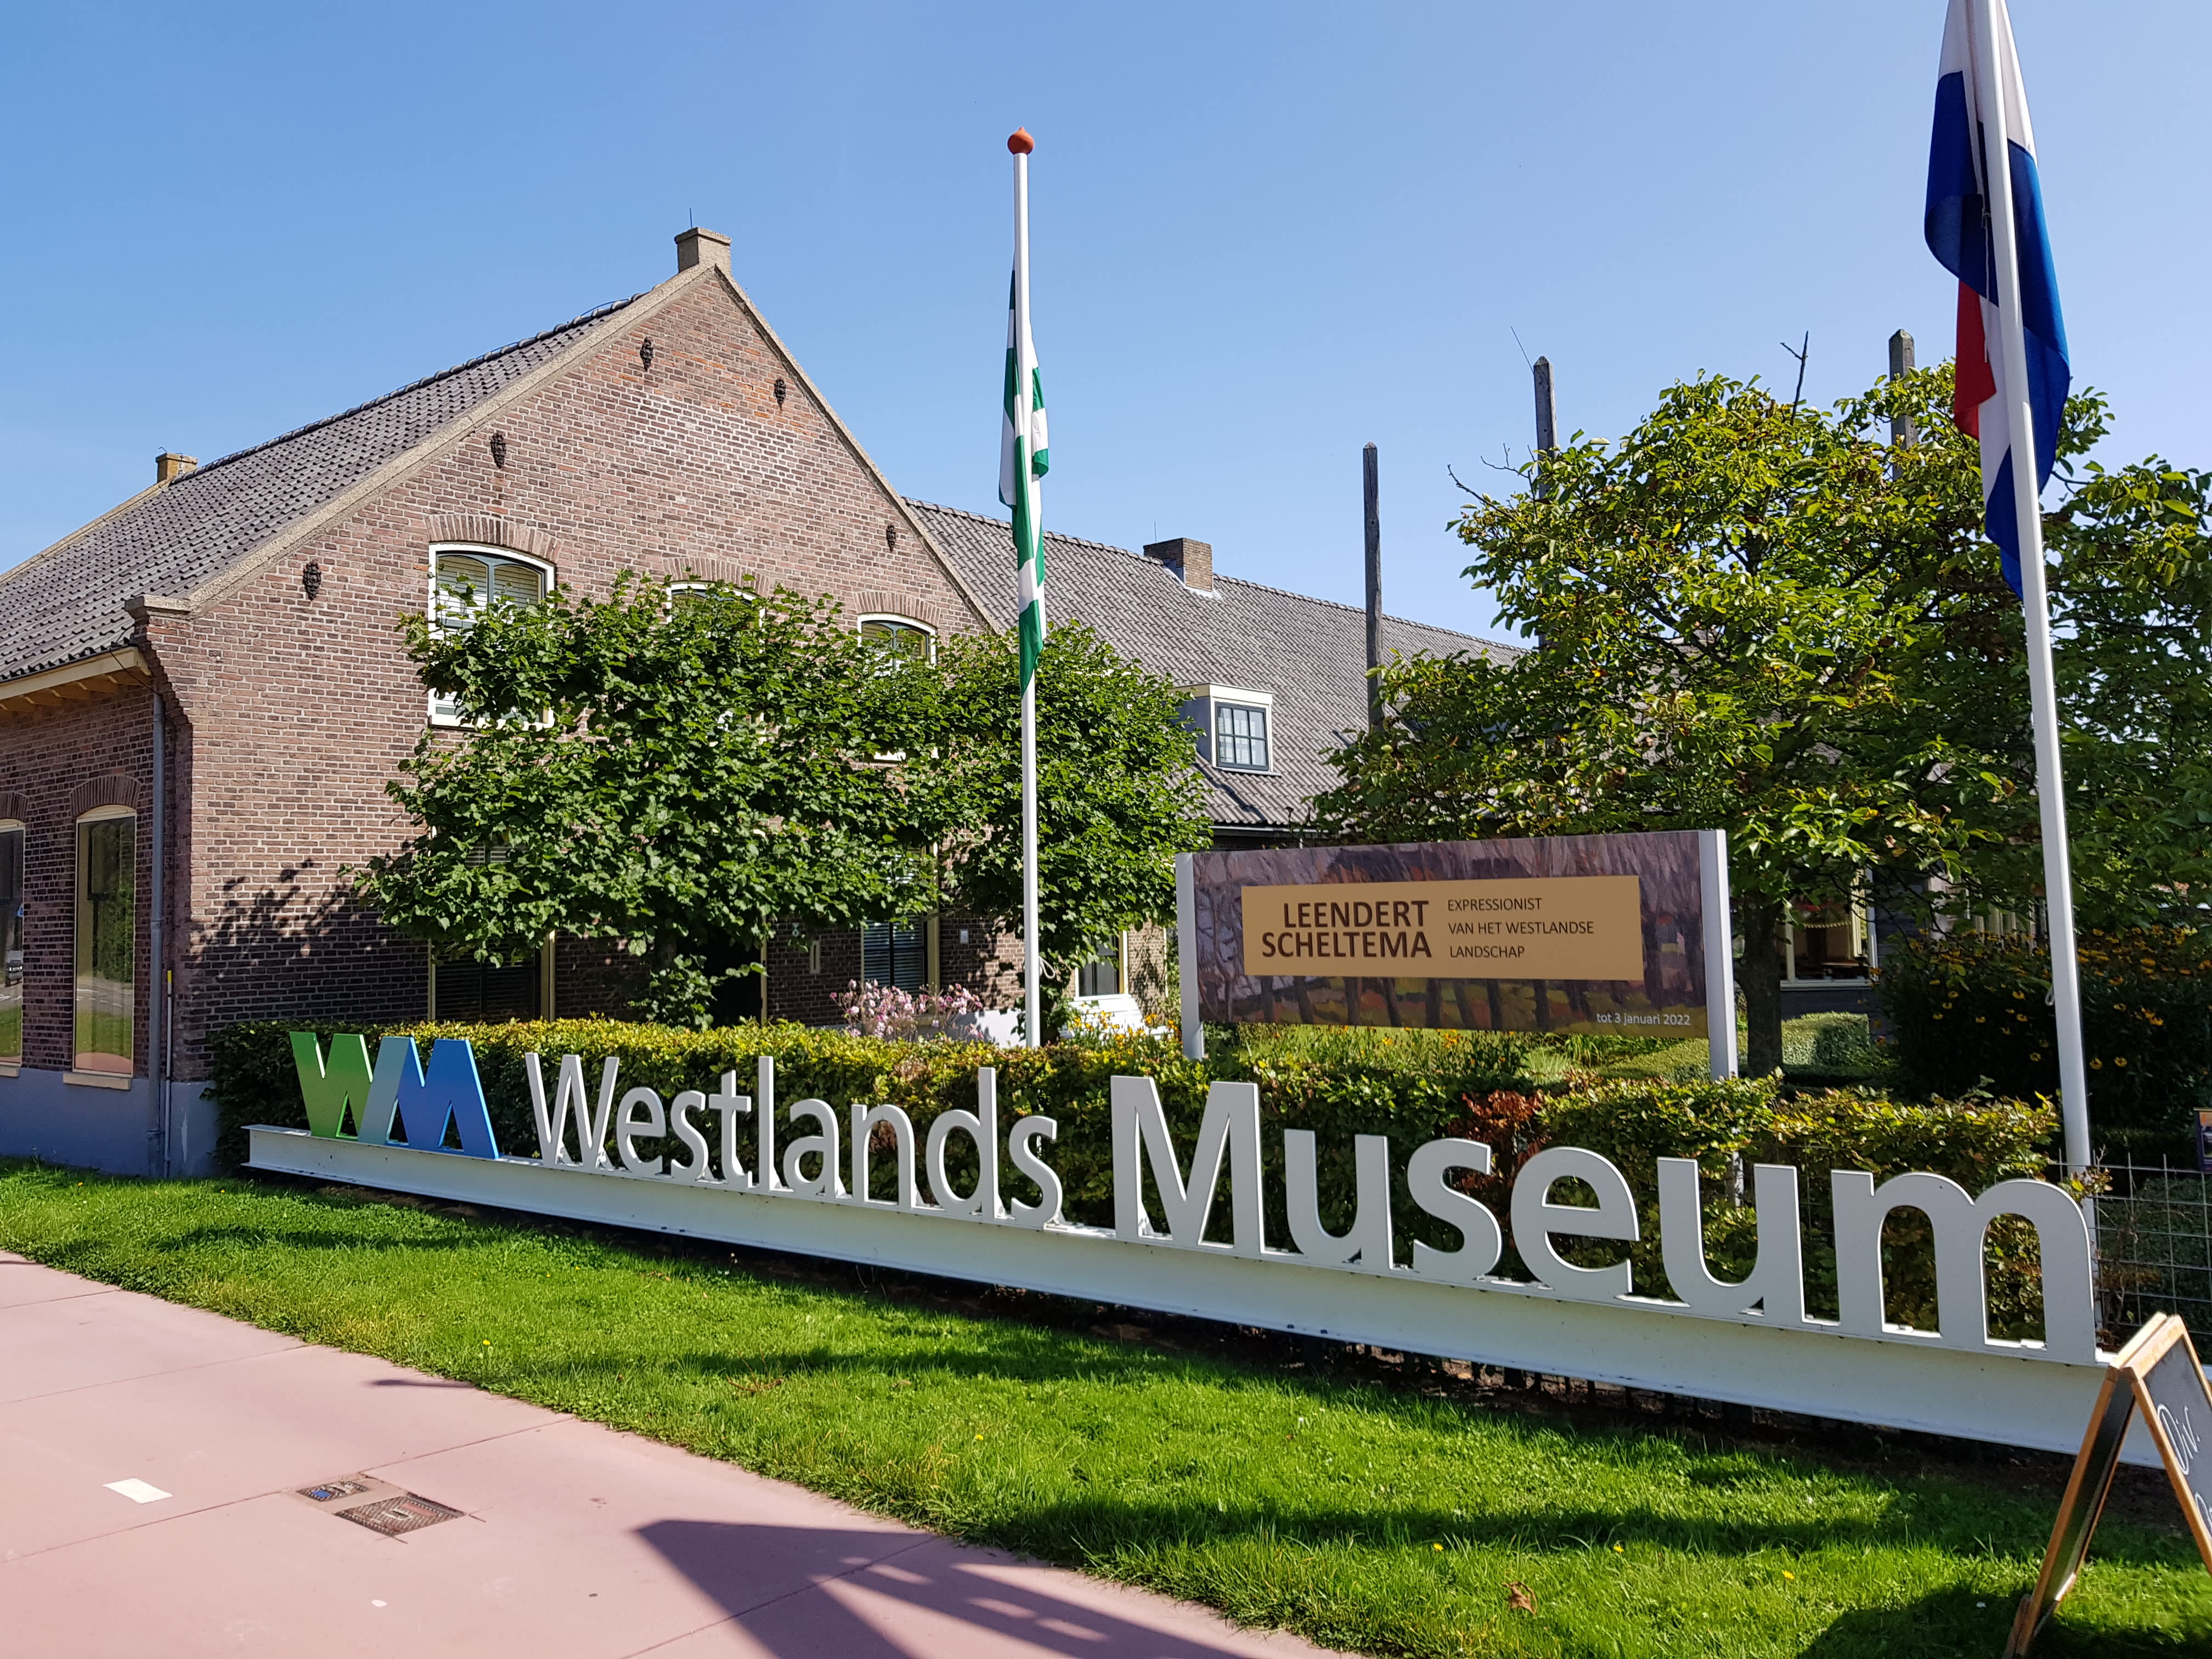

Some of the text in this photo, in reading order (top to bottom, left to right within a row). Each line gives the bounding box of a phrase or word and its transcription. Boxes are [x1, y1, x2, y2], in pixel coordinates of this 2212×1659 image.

[1284, 900, 1429, 928] LEENDERT
[1448, 898, 1542, 911] EXPRESSIONIST
[1448, 921, 1594, 934] VAN HET WESTLANDSE
[1262, 931, 1432, 957] SCHELTEMA
[1449, 945, 1525, 958] LANDSCHAP
[1596, 1012, 1690, 1026] tot 3 januari 2022
[289, 1031, 500, 1159] WM
[525, 1056, 2098, 1364] Westlands Museum
